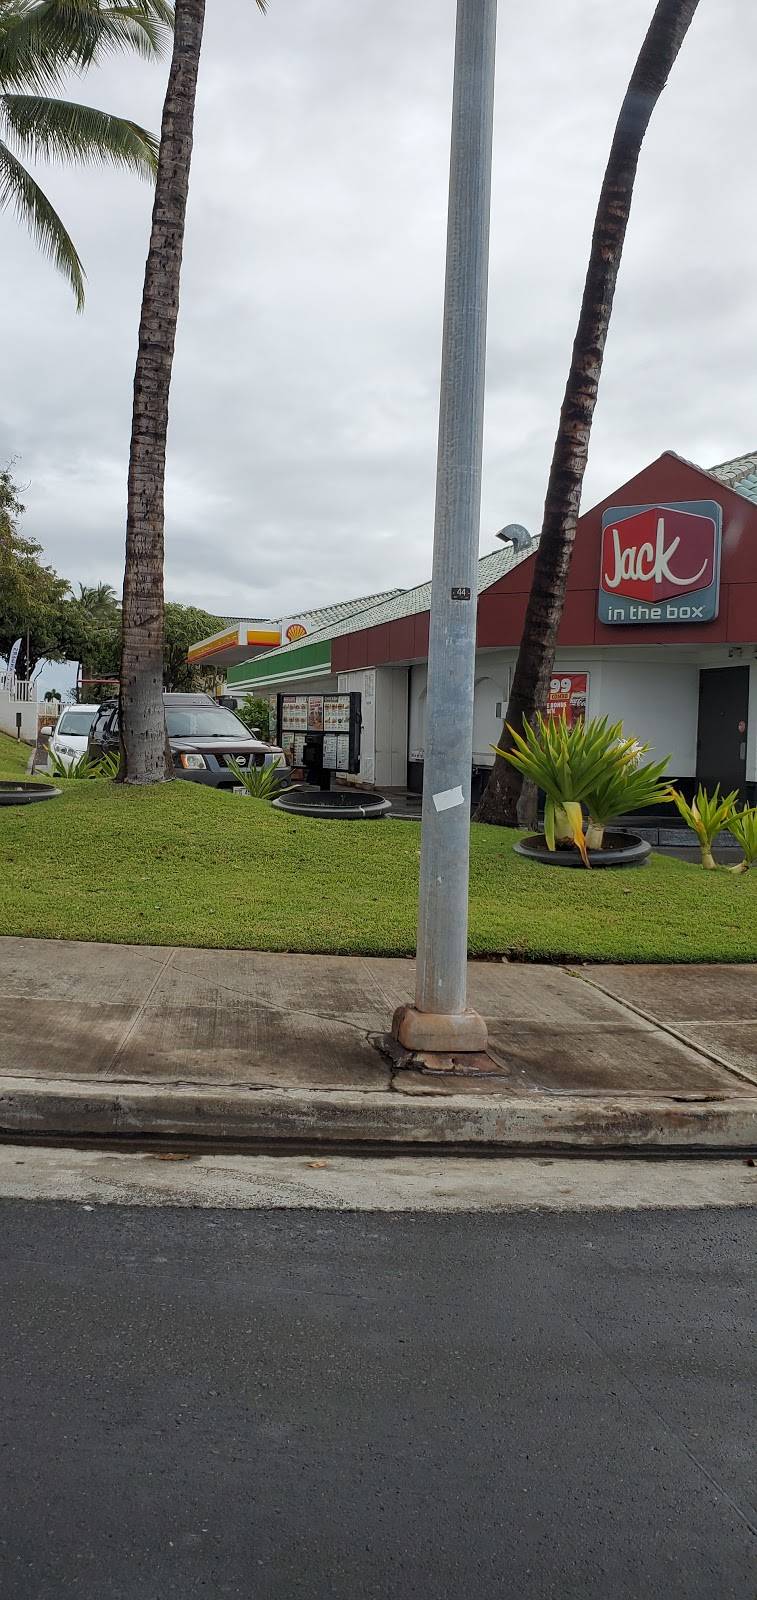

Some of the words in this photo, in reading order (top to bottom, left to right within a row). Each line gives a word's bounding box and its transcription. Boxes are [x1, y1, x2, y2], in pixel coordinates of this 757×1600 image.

[604, 518, 708, 588] Jack
[457, 588, 466, 596] 44
[608, 606, 624, 621] in
[629, 605, 661, 620] the
[666, 604, 703, 619] box
